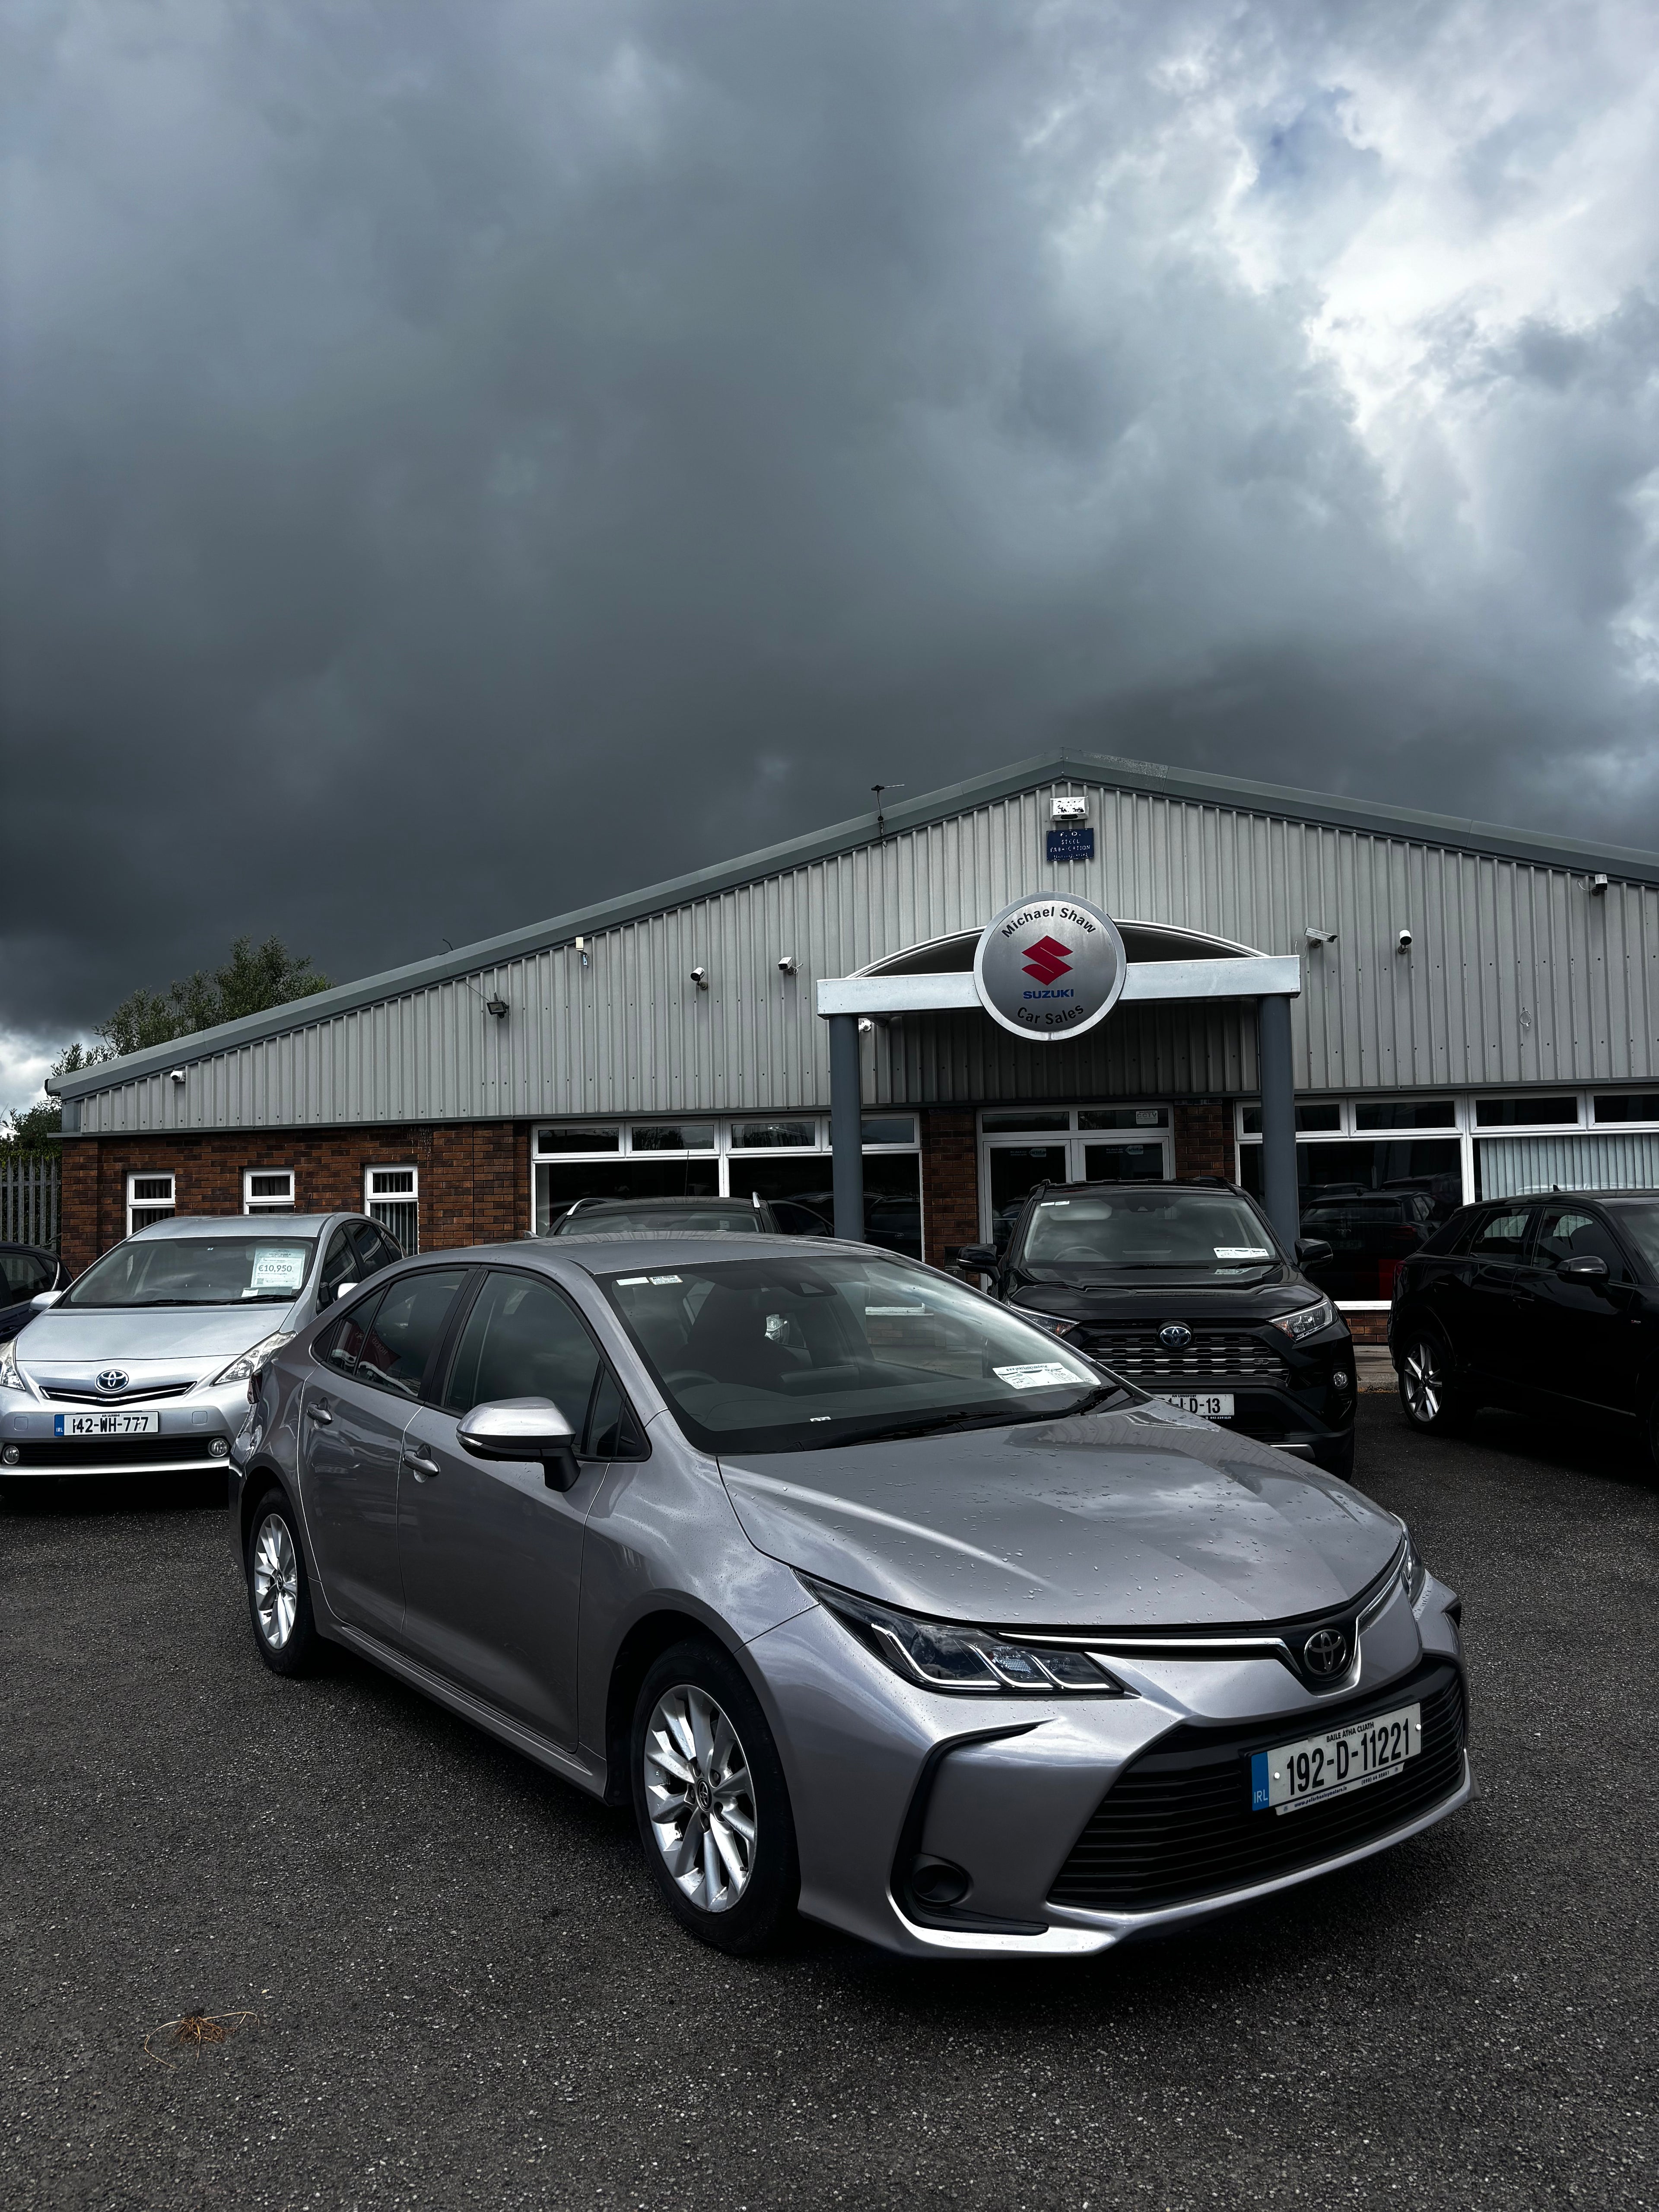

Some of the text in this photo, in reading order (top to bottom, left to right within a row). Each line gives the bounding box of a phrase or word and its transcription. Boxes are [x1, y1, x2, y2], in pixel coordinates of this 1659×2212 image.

[1001, 906, 1096, 938] Michael Shaw
[1023, 989, 1074, 999] SUZUKI
[1017, 1005, 1084, 1025] Car Sales
[73, 1417, 149, 1433] 142-WH-777
[1326, 1732, 1341, 1742] BAILE
[1357, 1721, 1374, 1733] CLIATH
[1287, 1718, 1409, 1796] 192-D-11221
[1254, 1789, 1268, 1804] IRL
